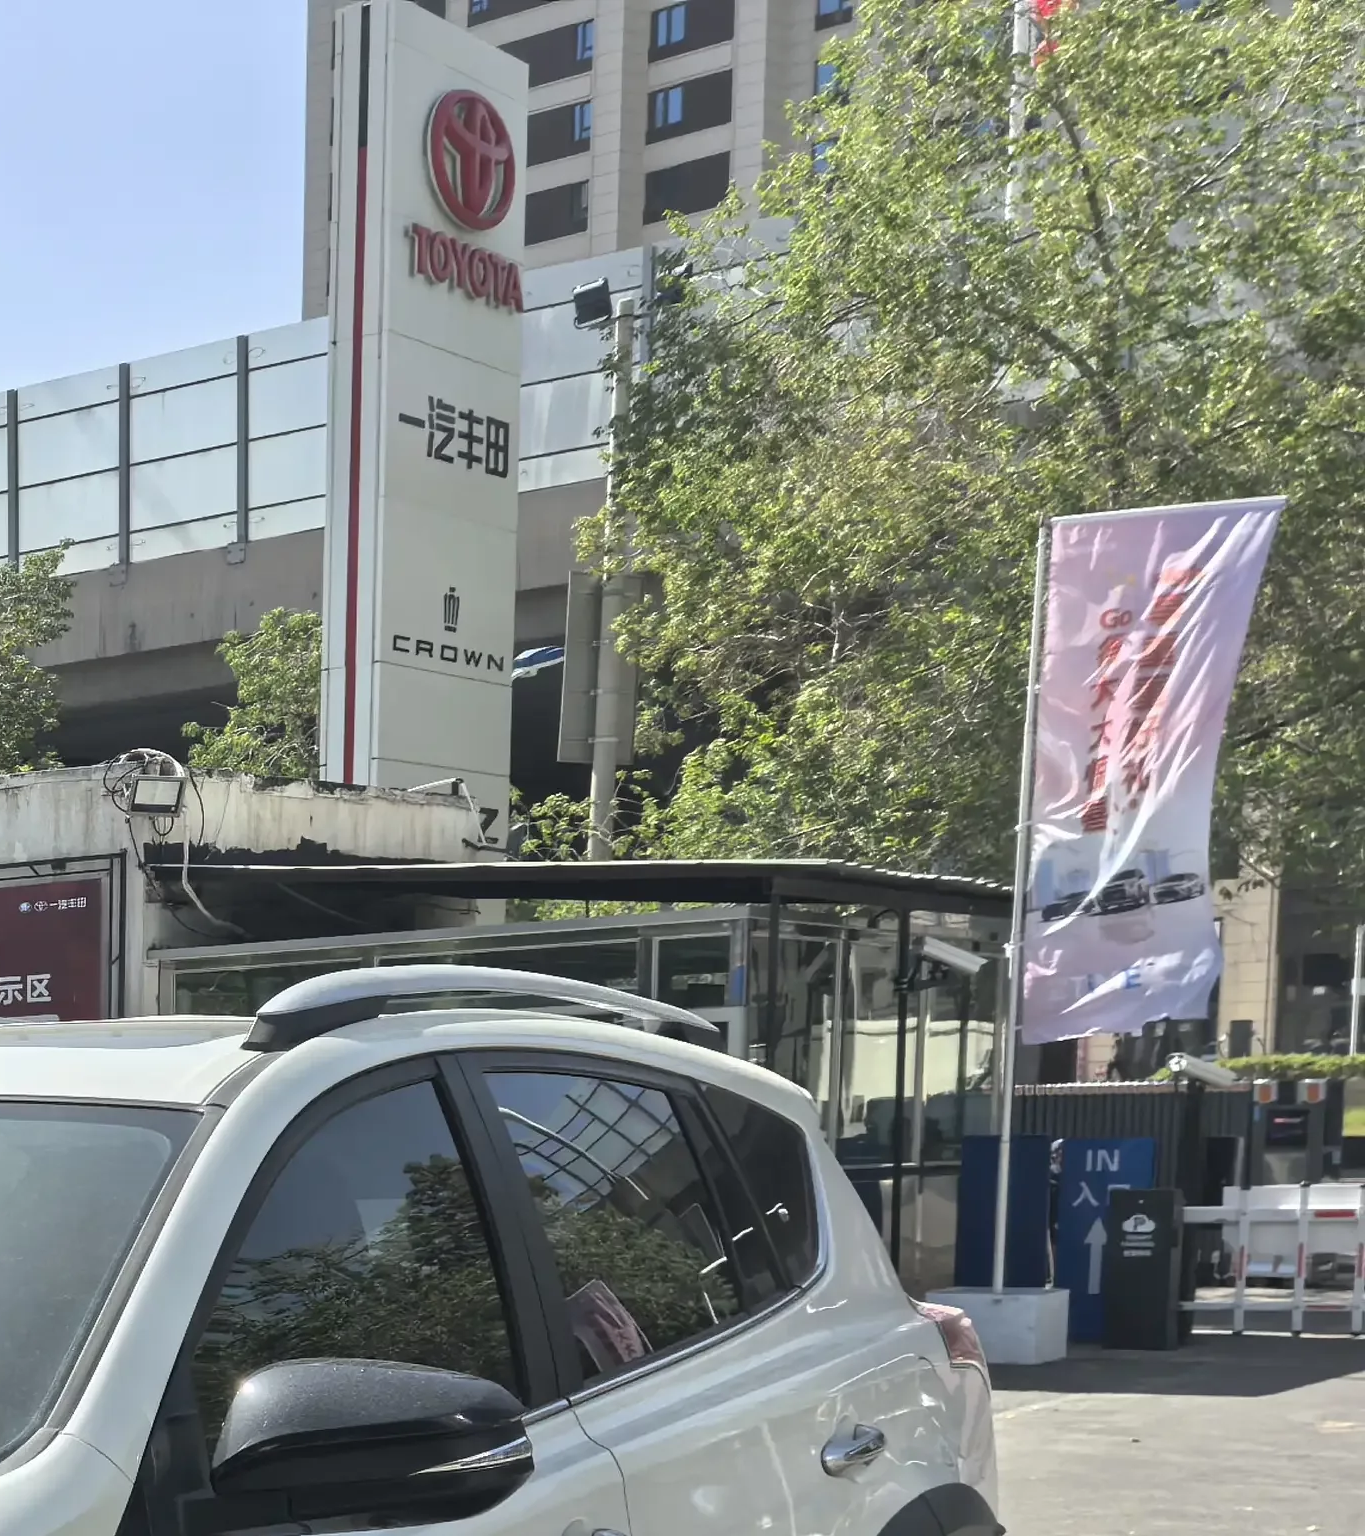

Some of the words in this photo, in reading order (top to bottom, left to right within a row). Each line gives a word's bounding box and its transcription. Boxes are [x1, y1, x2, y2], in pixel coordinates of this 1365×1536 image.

[410, 222, 524, 313] TOYOTA
[398, 394, 510, 479] 一汽丰田
[391, 634, 506, 673] CROWN
[1085, 1149, 1120, 1172] IN
